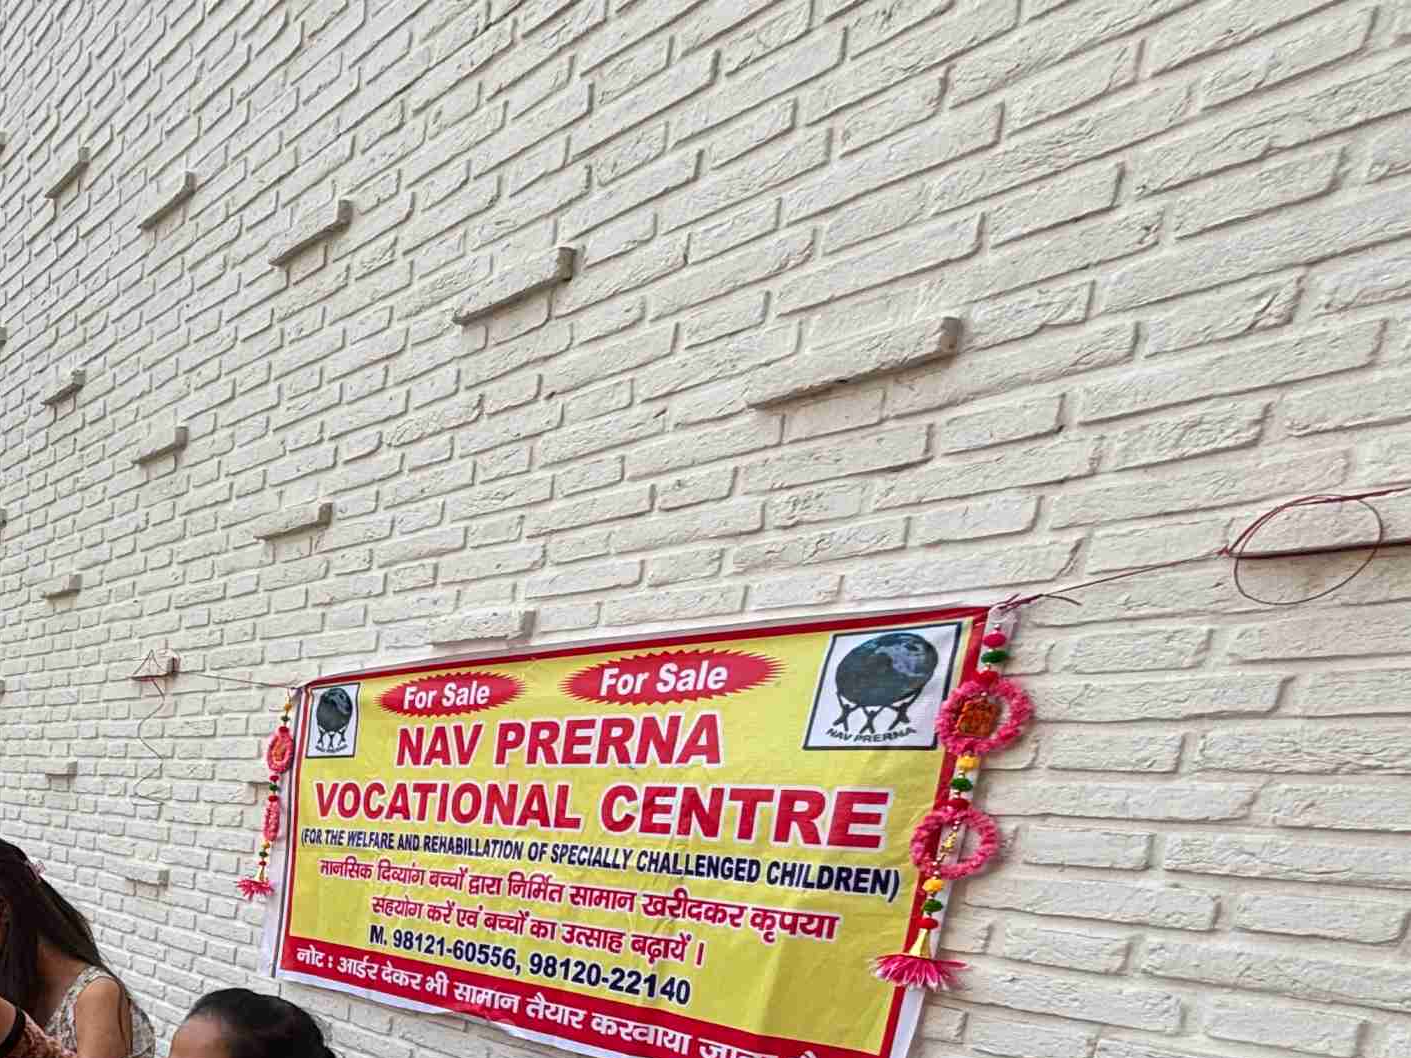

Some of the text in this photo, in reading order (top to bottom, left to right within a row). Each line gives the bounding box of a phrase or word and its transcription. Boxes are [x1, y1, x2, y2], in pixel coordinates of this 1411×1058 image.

[402, 681, 490, 710] For Sale
[599, 660, 729, 696] For Sale
[396, 713, 722, 767] NAV PRERNA
[826, 727, 917, 743] NAV PRERNA
[315, 782, 890, 850] VOCATIONAL CENTRE
[300, 827, 901, 902] (FOR THE WELFARE AND REHABILLATION OF SPECIALLY CHALLENGED CHILDREN)
[372, 895, 424, 918] सहयोग
[427, 900, 456, 924] करें
[456, 905, 483, 928] एवं
[483, 911, 530, 935] बच्चों
[529, 919, 557, 939] का
[561, 924, 626, 954] उत्साह
[377, 859, 426, 886] दिव्यांग
[428, 866, 468, 890] बच्चों
[468, 874, 503, 896] द्वारा
[507, 871, 565, 903] निर्मित
[569, 884, 637, 913] सामान
[642, 888, 748, 928] खरीदकर
[749, 906, 841, 943] कृपया
[369, 925, 691, 1005] M. 98121-60556, 98120-22140
[337, 955, 380, 980] आर्डर
[381, 961, 423, 991] देकर
[424, 970, 449, 997] भी
[453, 981, 521, 1015] सामान
[525, 992, 588, 1029] तैयार
[591, 1011, 694, 1056] करवाया
